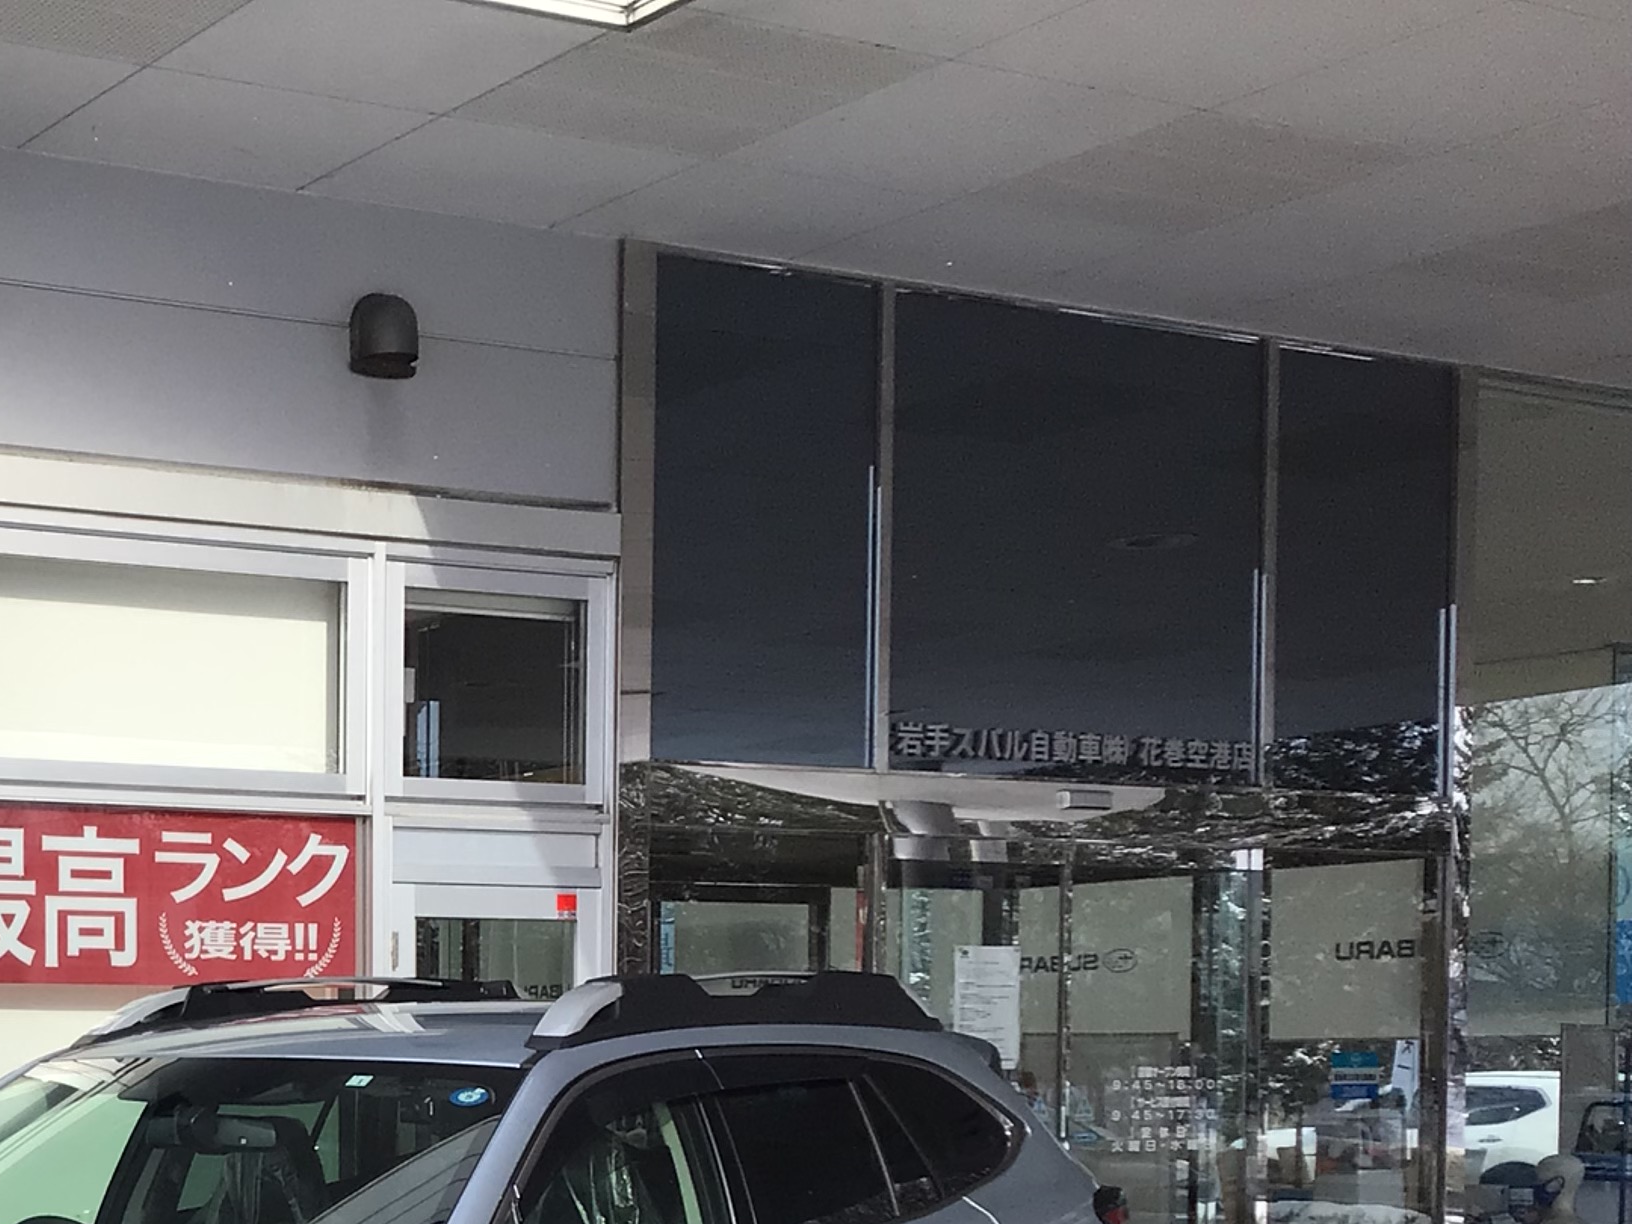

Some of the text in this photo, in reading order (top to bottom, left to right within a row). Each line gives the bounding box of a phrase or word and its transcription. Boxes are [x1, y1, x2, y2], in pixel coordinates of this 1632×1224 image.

[1141, 736, 1254, 771] 花巻空港店
[154, 831, 350, 907] ランク
[183, 919, 318, 962] 獲得!!
